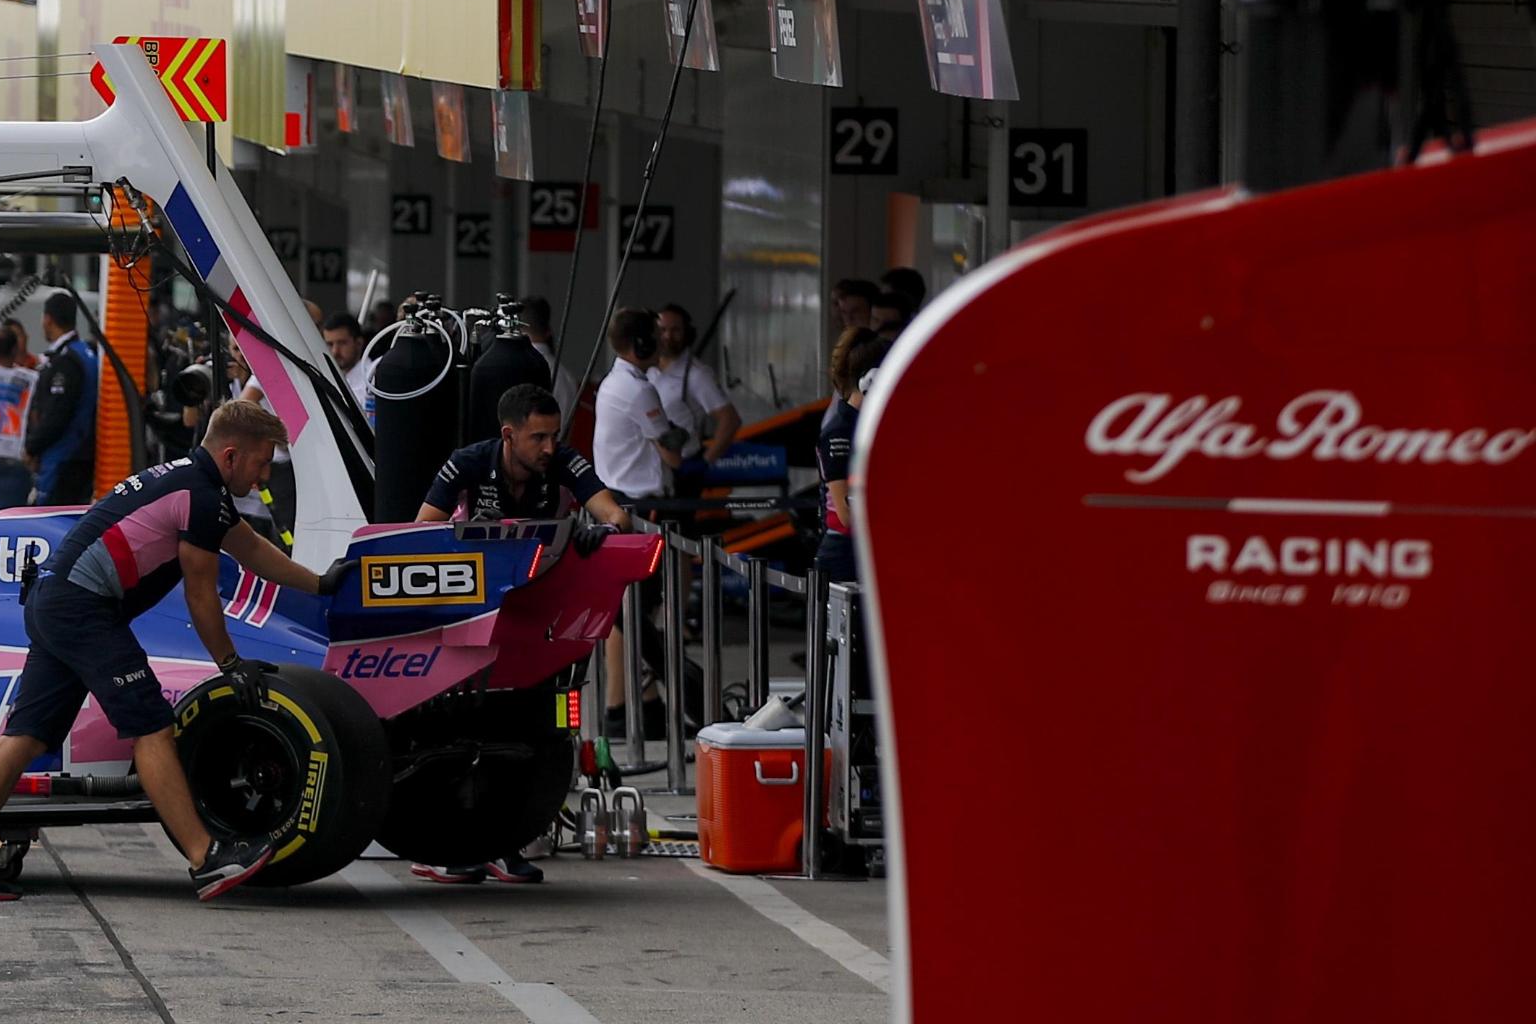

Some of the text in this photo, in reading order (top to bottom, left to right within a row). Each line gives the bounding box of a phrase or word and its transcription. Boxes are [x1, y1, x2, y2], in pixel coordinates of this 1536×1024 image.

[838, 119, 890, 164] 29
[1014, 143, 1073, 195] 31
[394, 200, 428, 230] 21
[533, 191, 577, 225] 25
[458, 223, 491, 252] 23
[622, 216, 671, 252] 27
[1086, 390, 1536, 483] Alfa Romeo
[1187, 536, 1432, 578] RACING
[372, 564, 477, 597] JCB
[125, 669, 147, 683] BWT
[340, 645, 441, 679] telcel
[297, 750, 328, 832] PIRELLI
